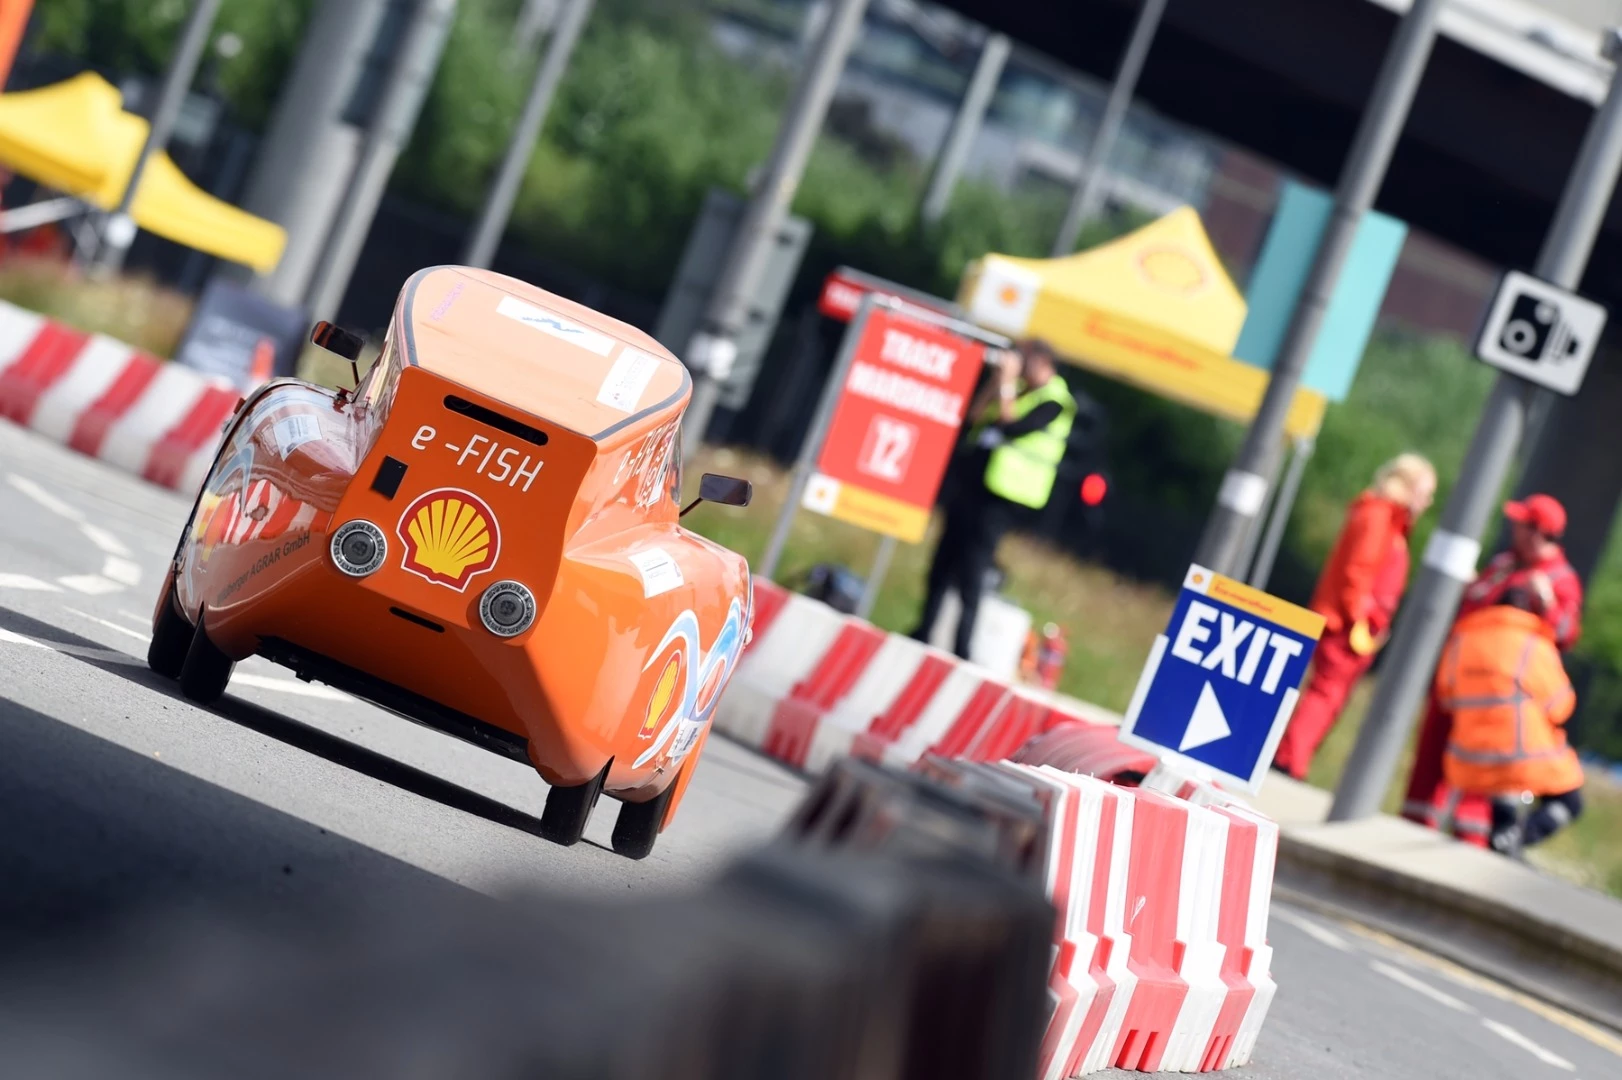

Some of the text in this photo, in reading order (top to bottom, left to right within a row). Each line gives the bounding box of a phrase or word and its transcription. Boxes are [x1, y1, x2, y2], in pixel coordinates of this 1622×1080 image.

[880, 327, 958, 382] TRACK
[868, 419, 912, 479] 12
[250, 547, 281, 576] AGRAR
[282, 529, 311, 558] GmbH
[1171, 599, 1304, 695] EXIT
